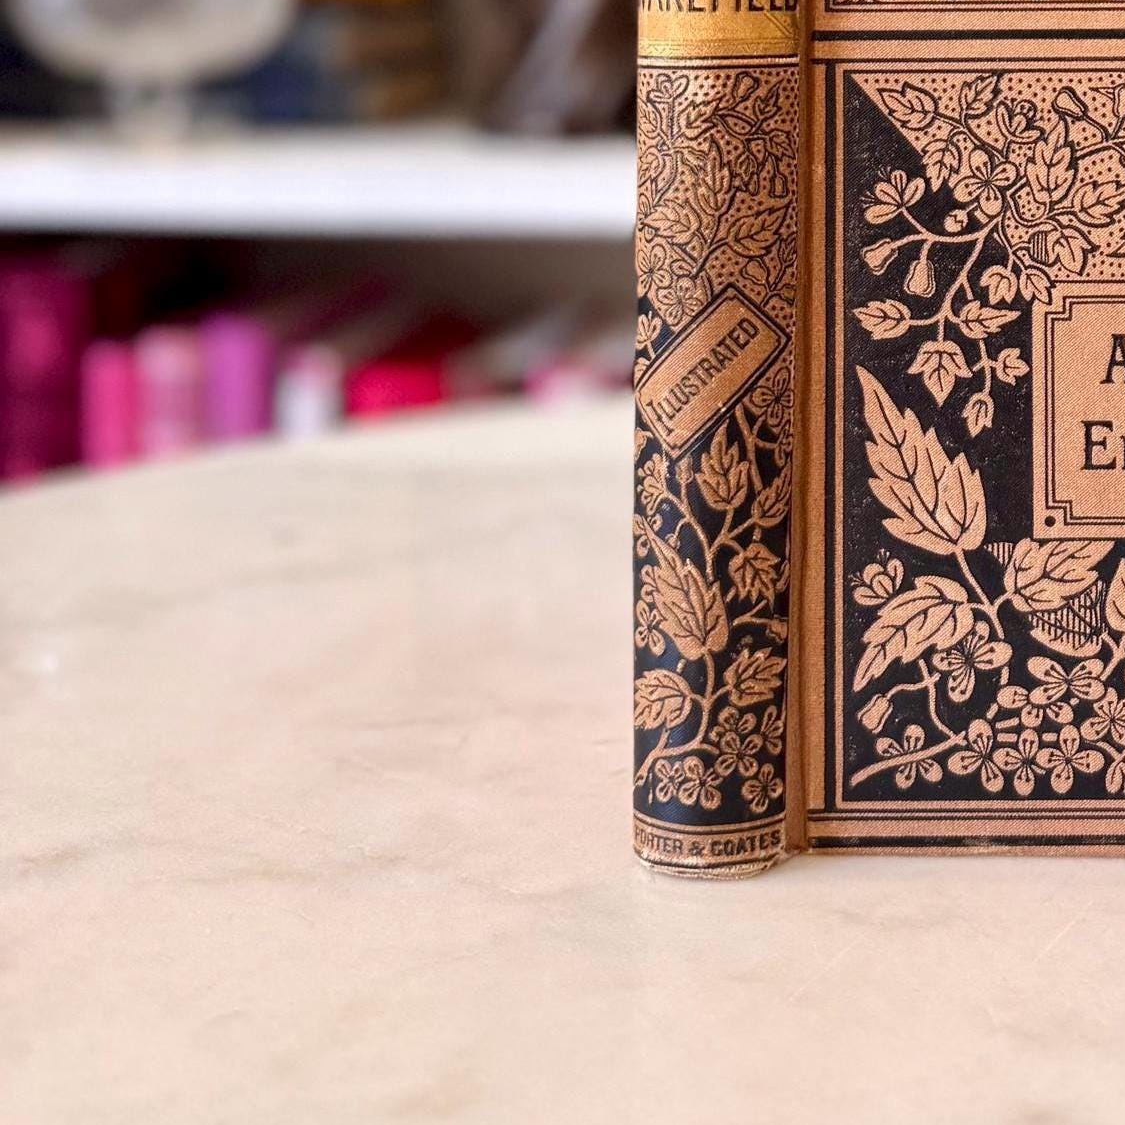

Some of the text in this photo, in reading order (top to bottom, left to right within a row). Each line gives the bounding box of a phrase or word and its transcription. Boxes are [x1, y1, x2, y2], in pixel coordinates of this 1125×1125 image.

[646, 317, 760, 437] ILLUSTRATED
[688, 841, 705, 857] &
[711, 830, 781, 856] COATES
